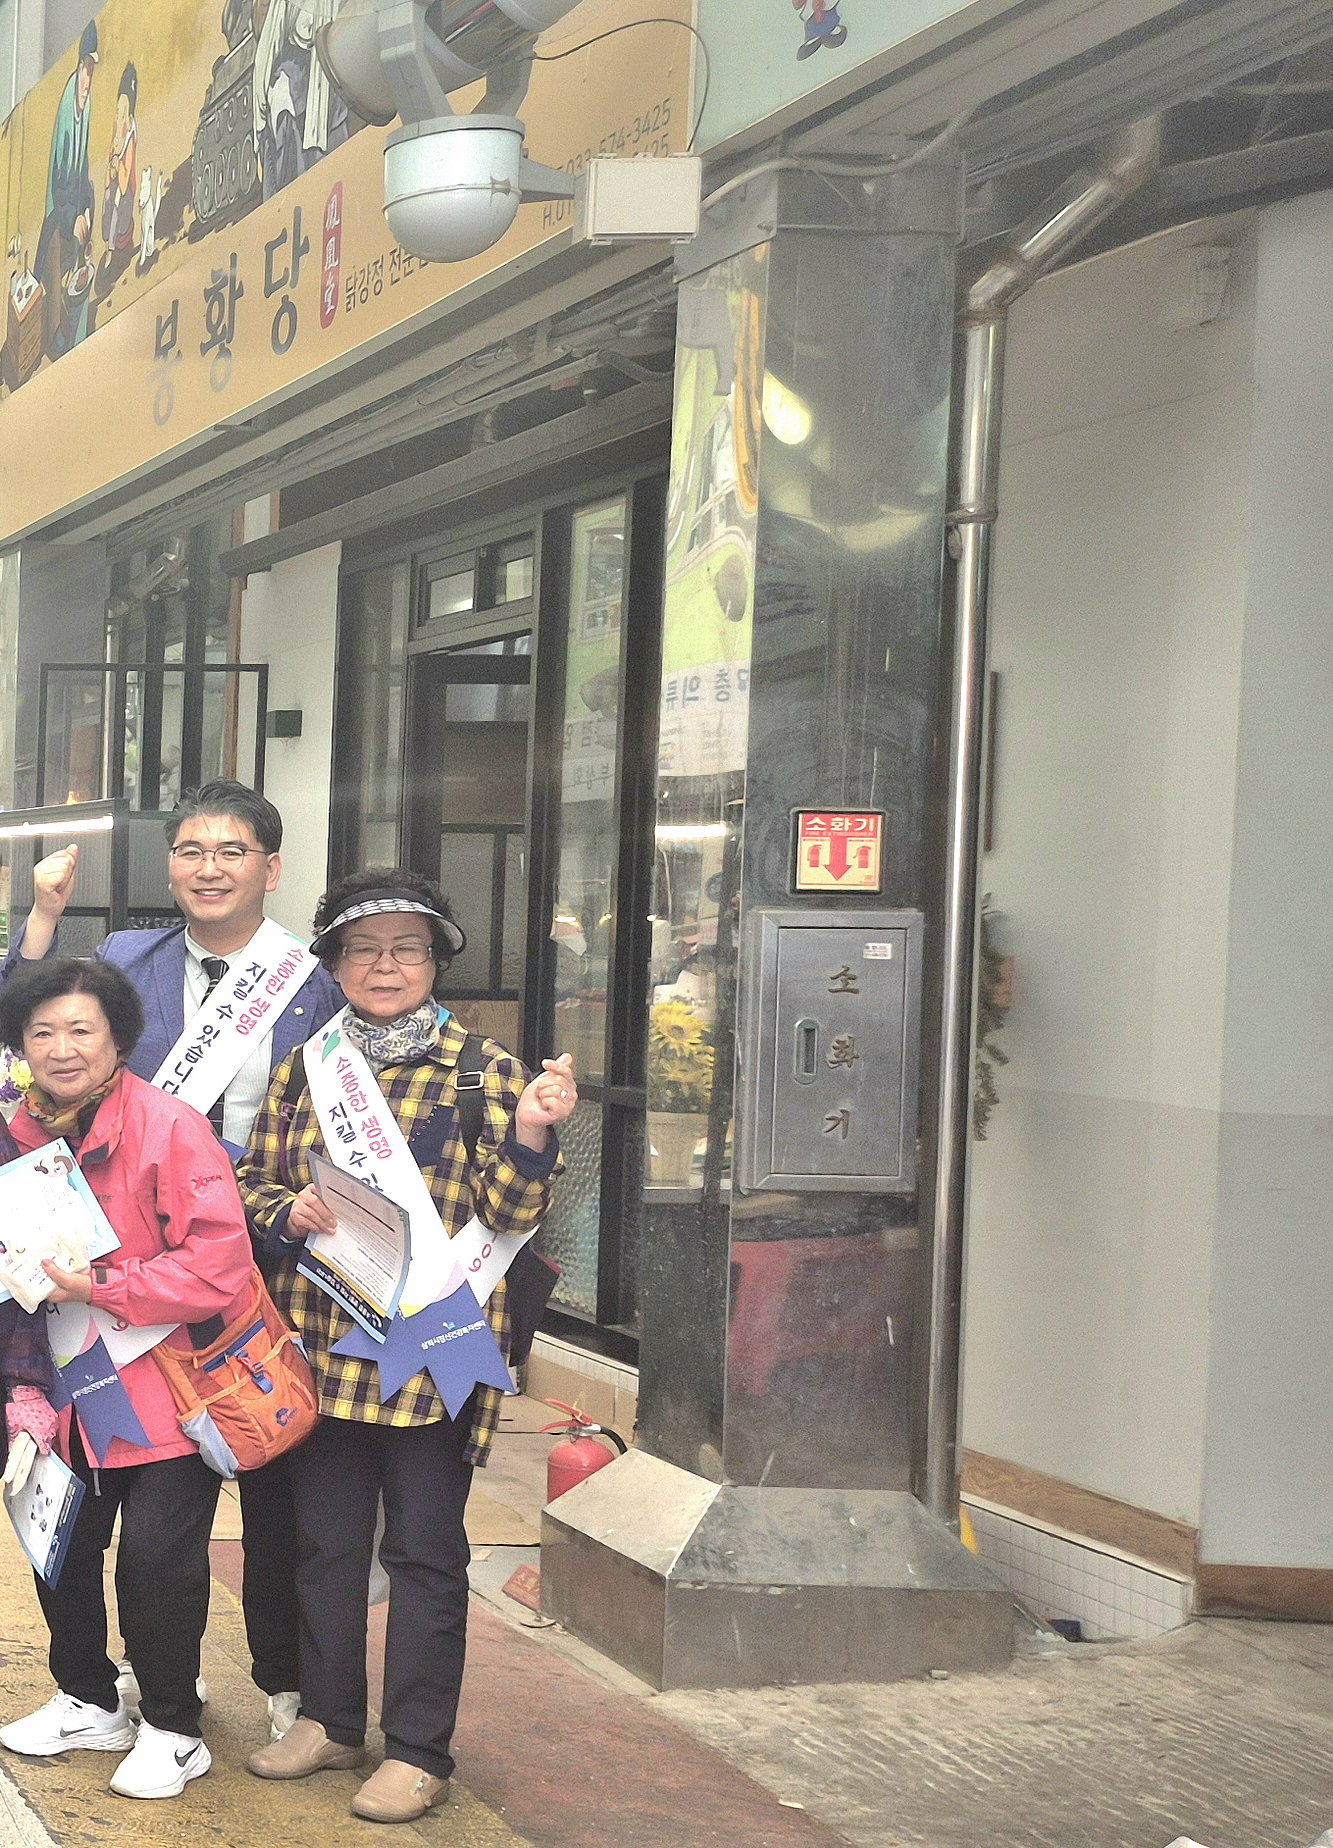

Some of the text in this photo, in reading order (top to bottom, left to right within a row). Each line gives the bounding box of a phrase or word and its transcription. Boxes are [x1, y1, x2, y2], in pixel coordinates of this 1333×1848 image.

[146, 205, 310, 428] 봉황당
[345, 244, 430, 314] 닭강정 전문
[805, 816, 875, 832] 소화기
[161, 961, 268, 1096] 지킬 수 있습니다
[235, 948, 305, 1036] 소중한 생명
[328, 1101, 368, 1168] 지킬 수
[335, 1055, 369, 1114] 소중한
[361, 1114, 393, 1161] 생명
